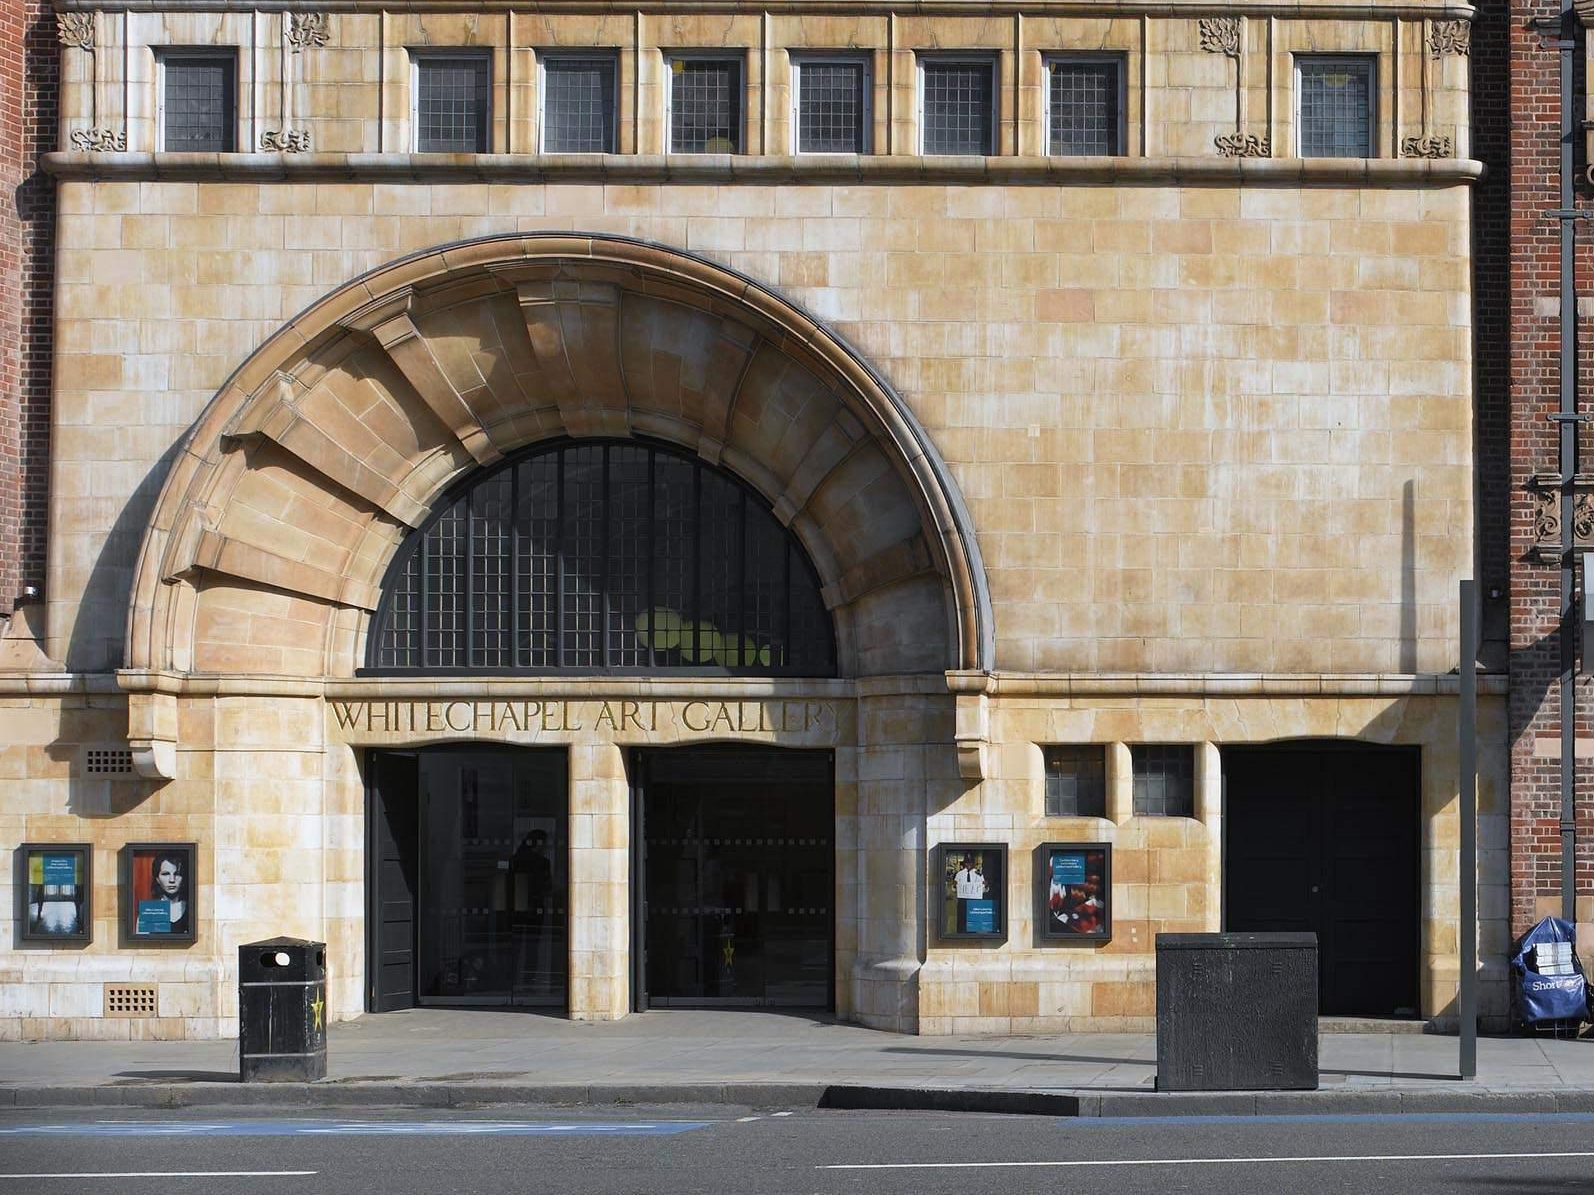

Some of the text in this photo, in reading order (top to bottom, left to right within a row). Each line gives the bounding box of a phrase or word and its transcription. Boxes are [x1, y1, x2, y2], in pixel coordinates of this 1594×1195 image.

[331, 699, 841, 732] WHITECHAPEL ART GALLERY
